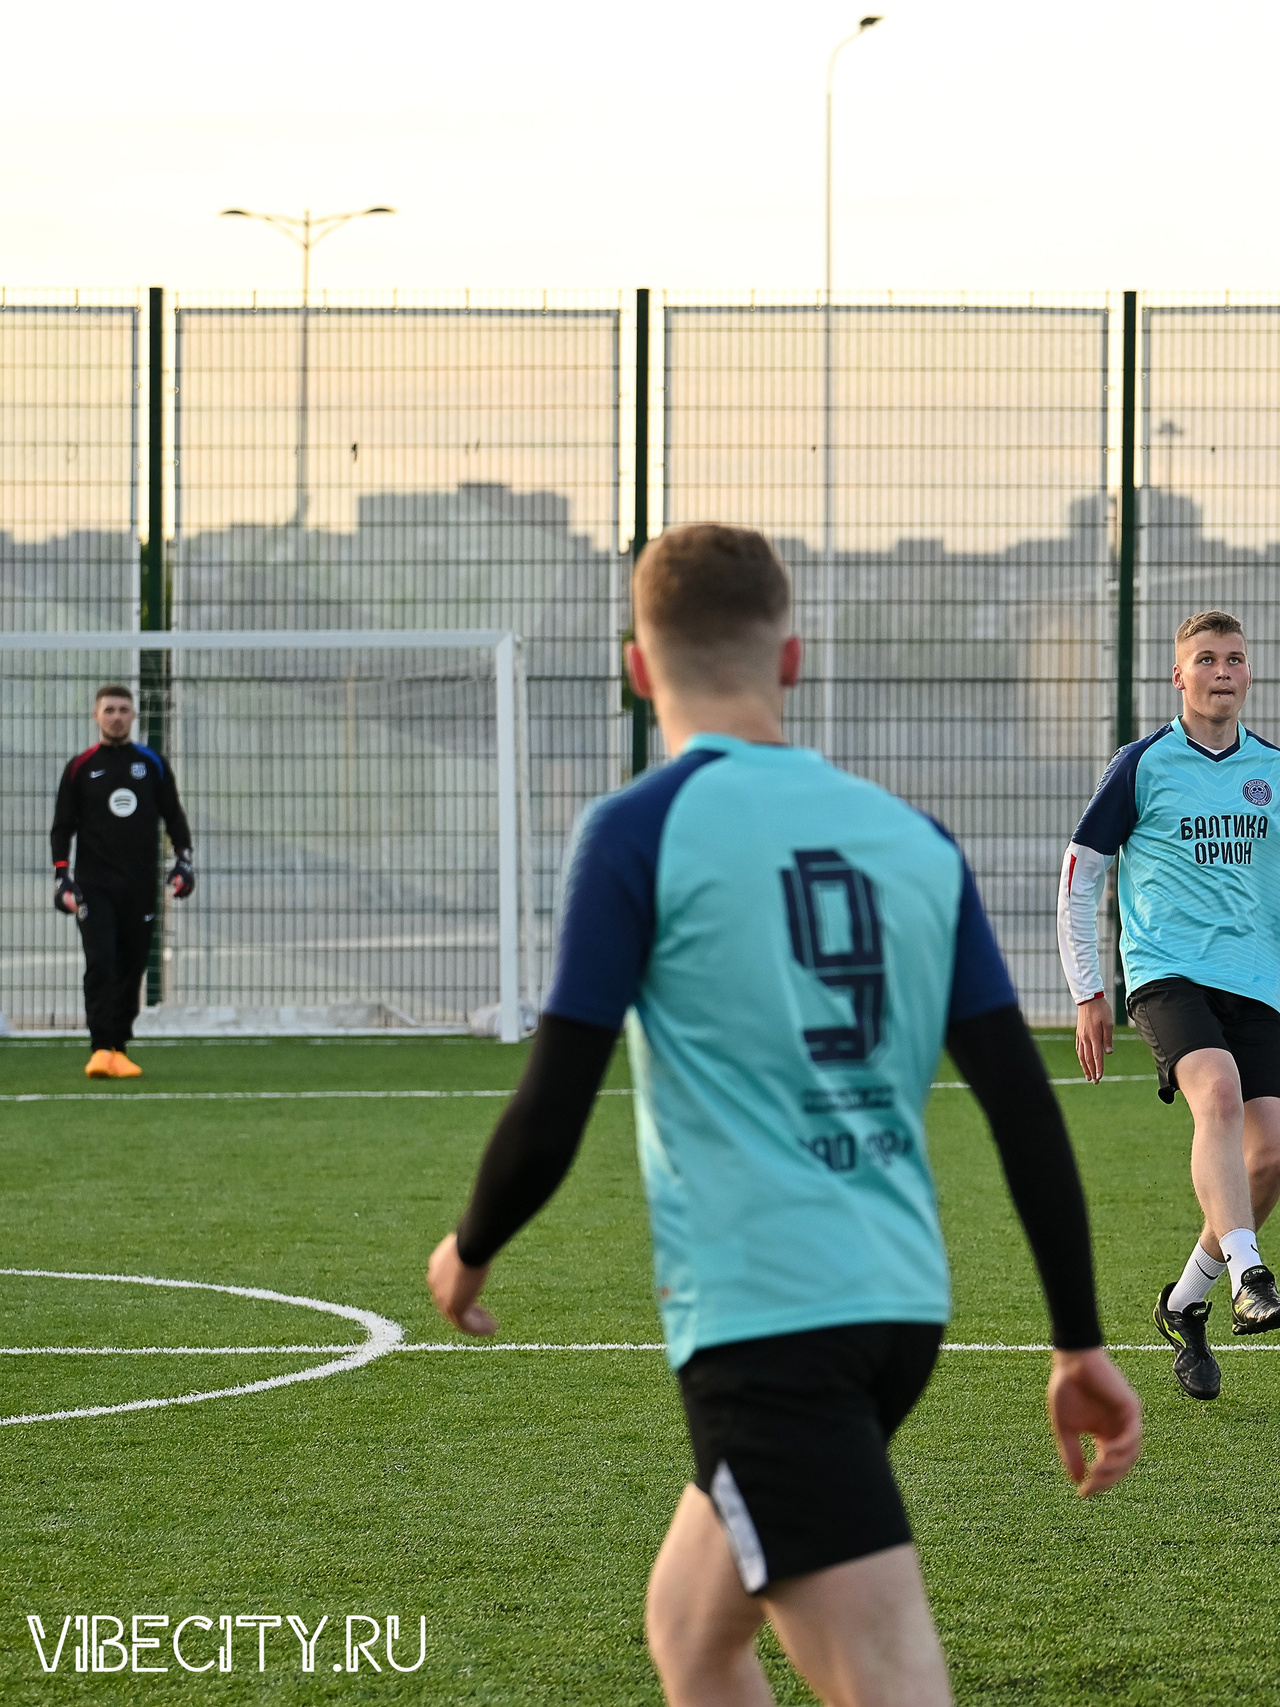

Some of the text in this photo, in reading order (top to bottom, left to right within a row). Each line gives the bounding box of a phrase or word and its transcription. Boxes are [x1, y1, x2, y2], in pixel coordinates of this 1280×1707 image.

[1180, 815, 1268, 841] БАЛТИКА
[1195, 841, 1252, 865] ОРИОН
[779, 848, 886, 1066] 9
